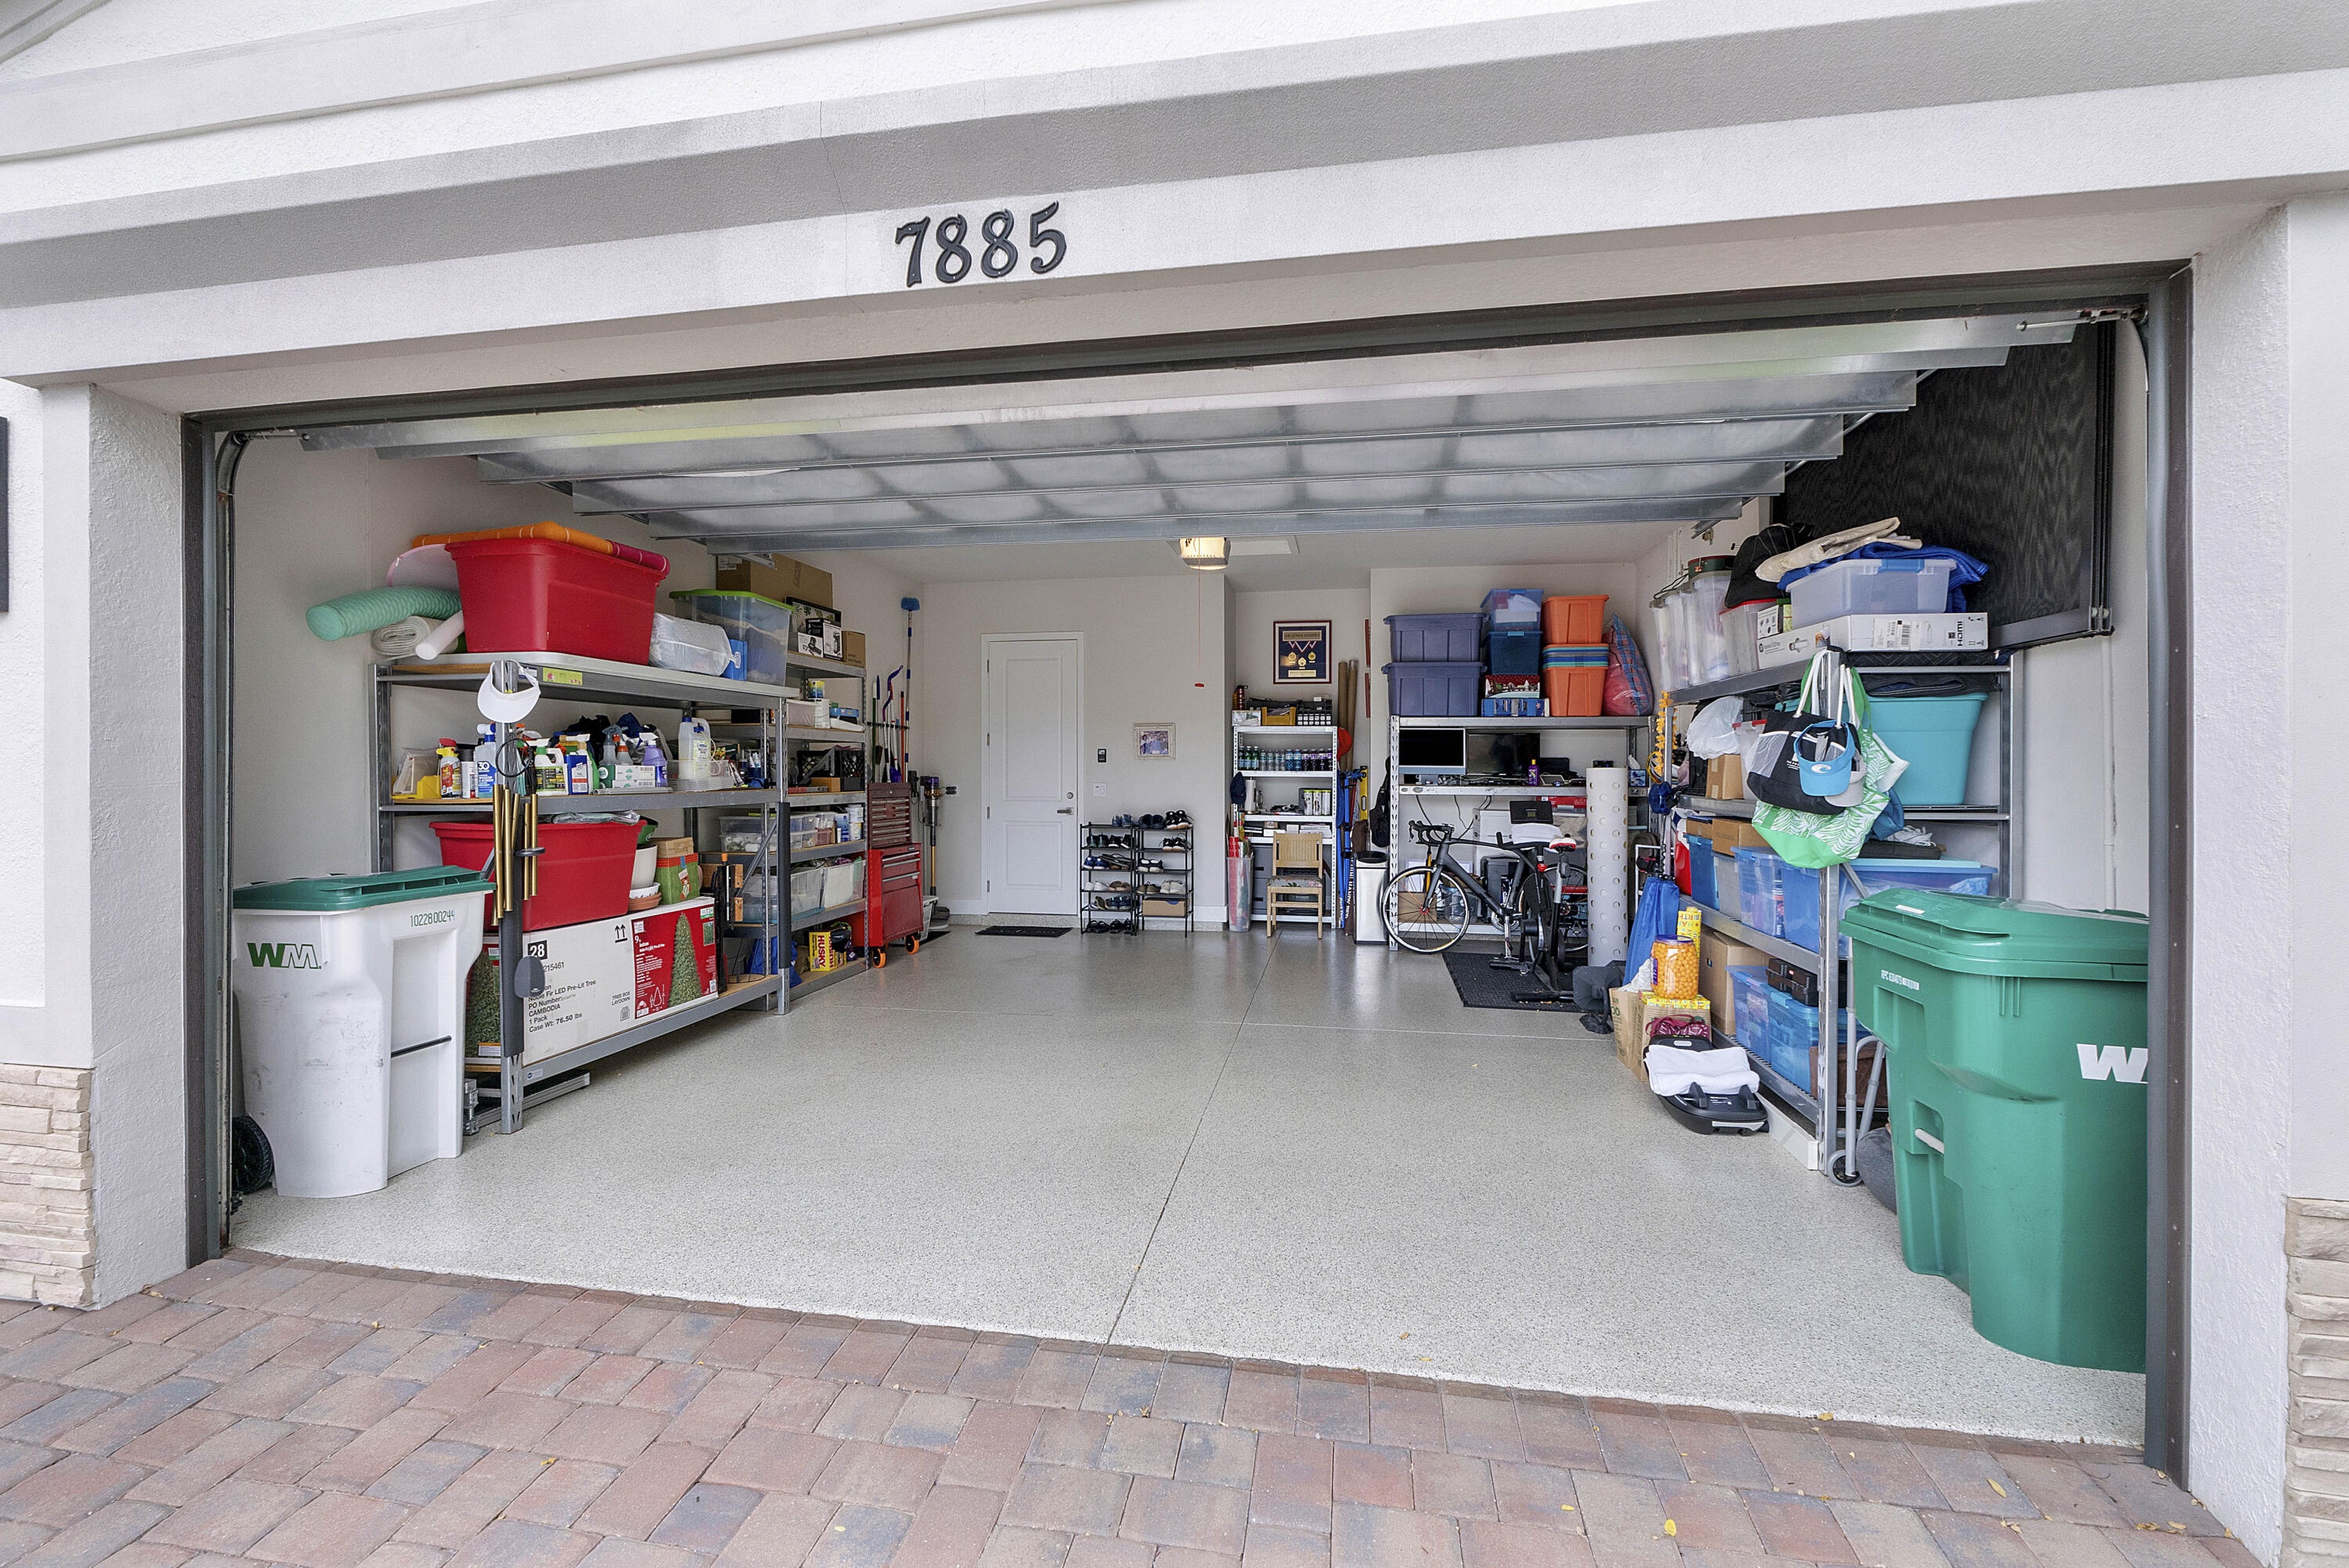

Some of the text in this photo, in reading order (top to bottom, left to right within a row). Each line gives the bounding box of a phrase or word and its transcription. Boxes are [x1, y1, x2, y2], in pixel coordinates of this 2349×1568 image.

[895, 200, 1067, 287] 7885
[478, 762, 490, 770] 30
[410, 910, 456, 928] 1022800244
[247, 943, 319, 970] WM
[529, 943, 546, 957] 28
[817, 935, 826, 968] HUSKY
[543, 961, 565, 972] 215461
[554, 986, 566, 995] LED
[567, 982, 585, 991] Pre-Lit
[538, 996, 563, 1007] Number:
[529, 1004, 561, 1017] CAMBODIA
[529, 1023, 544, 1033] Case
[555, 1015, 573, 1025] 76.50
[533, 1015, 548, 1024] Pack
[2077, 1043, 2149, 1084] W
